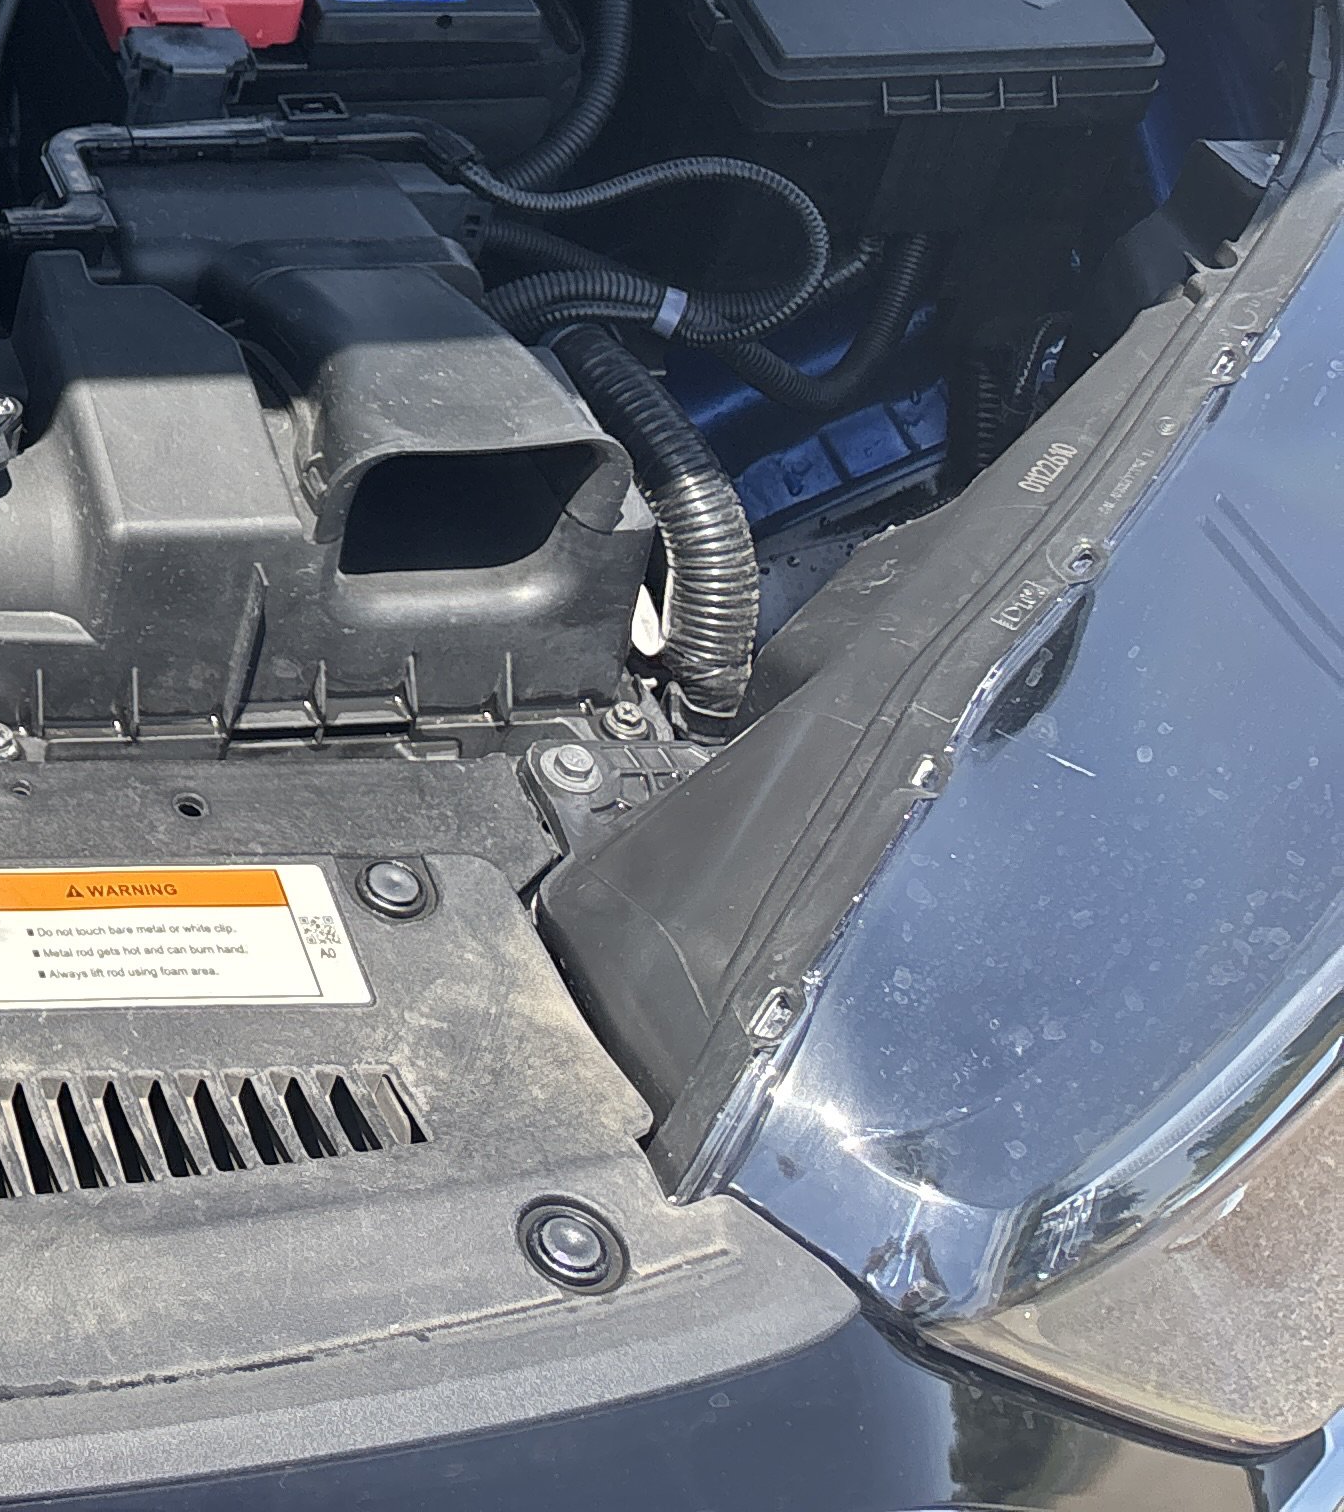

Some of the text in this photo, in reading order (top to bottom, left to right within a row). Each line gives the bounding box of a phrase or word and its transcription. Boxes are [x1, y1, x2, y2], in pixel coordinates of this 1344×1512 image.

[86, 883, 178, 898] WARNING
[36, 926, 53, 937] Do
[55, 926, 73, 937] not
[75, 926, 106, 937] touch
[108, 925, 133, 935] bare
[136, 924, 166, 934] metal
[169, 925, 180, 934] or
[182, 924, 211, 934] white
[42, 947, 73, 958] Metal
[76, 947, 94, 957] rod
[97, 947, 121, 959] gets
[122, 946, 141, 956] hot
[144, 945, 164, 956] and
[167, 946, 187, 955] can
[49, 966, 220, 980] Always lift rod using foam area.
